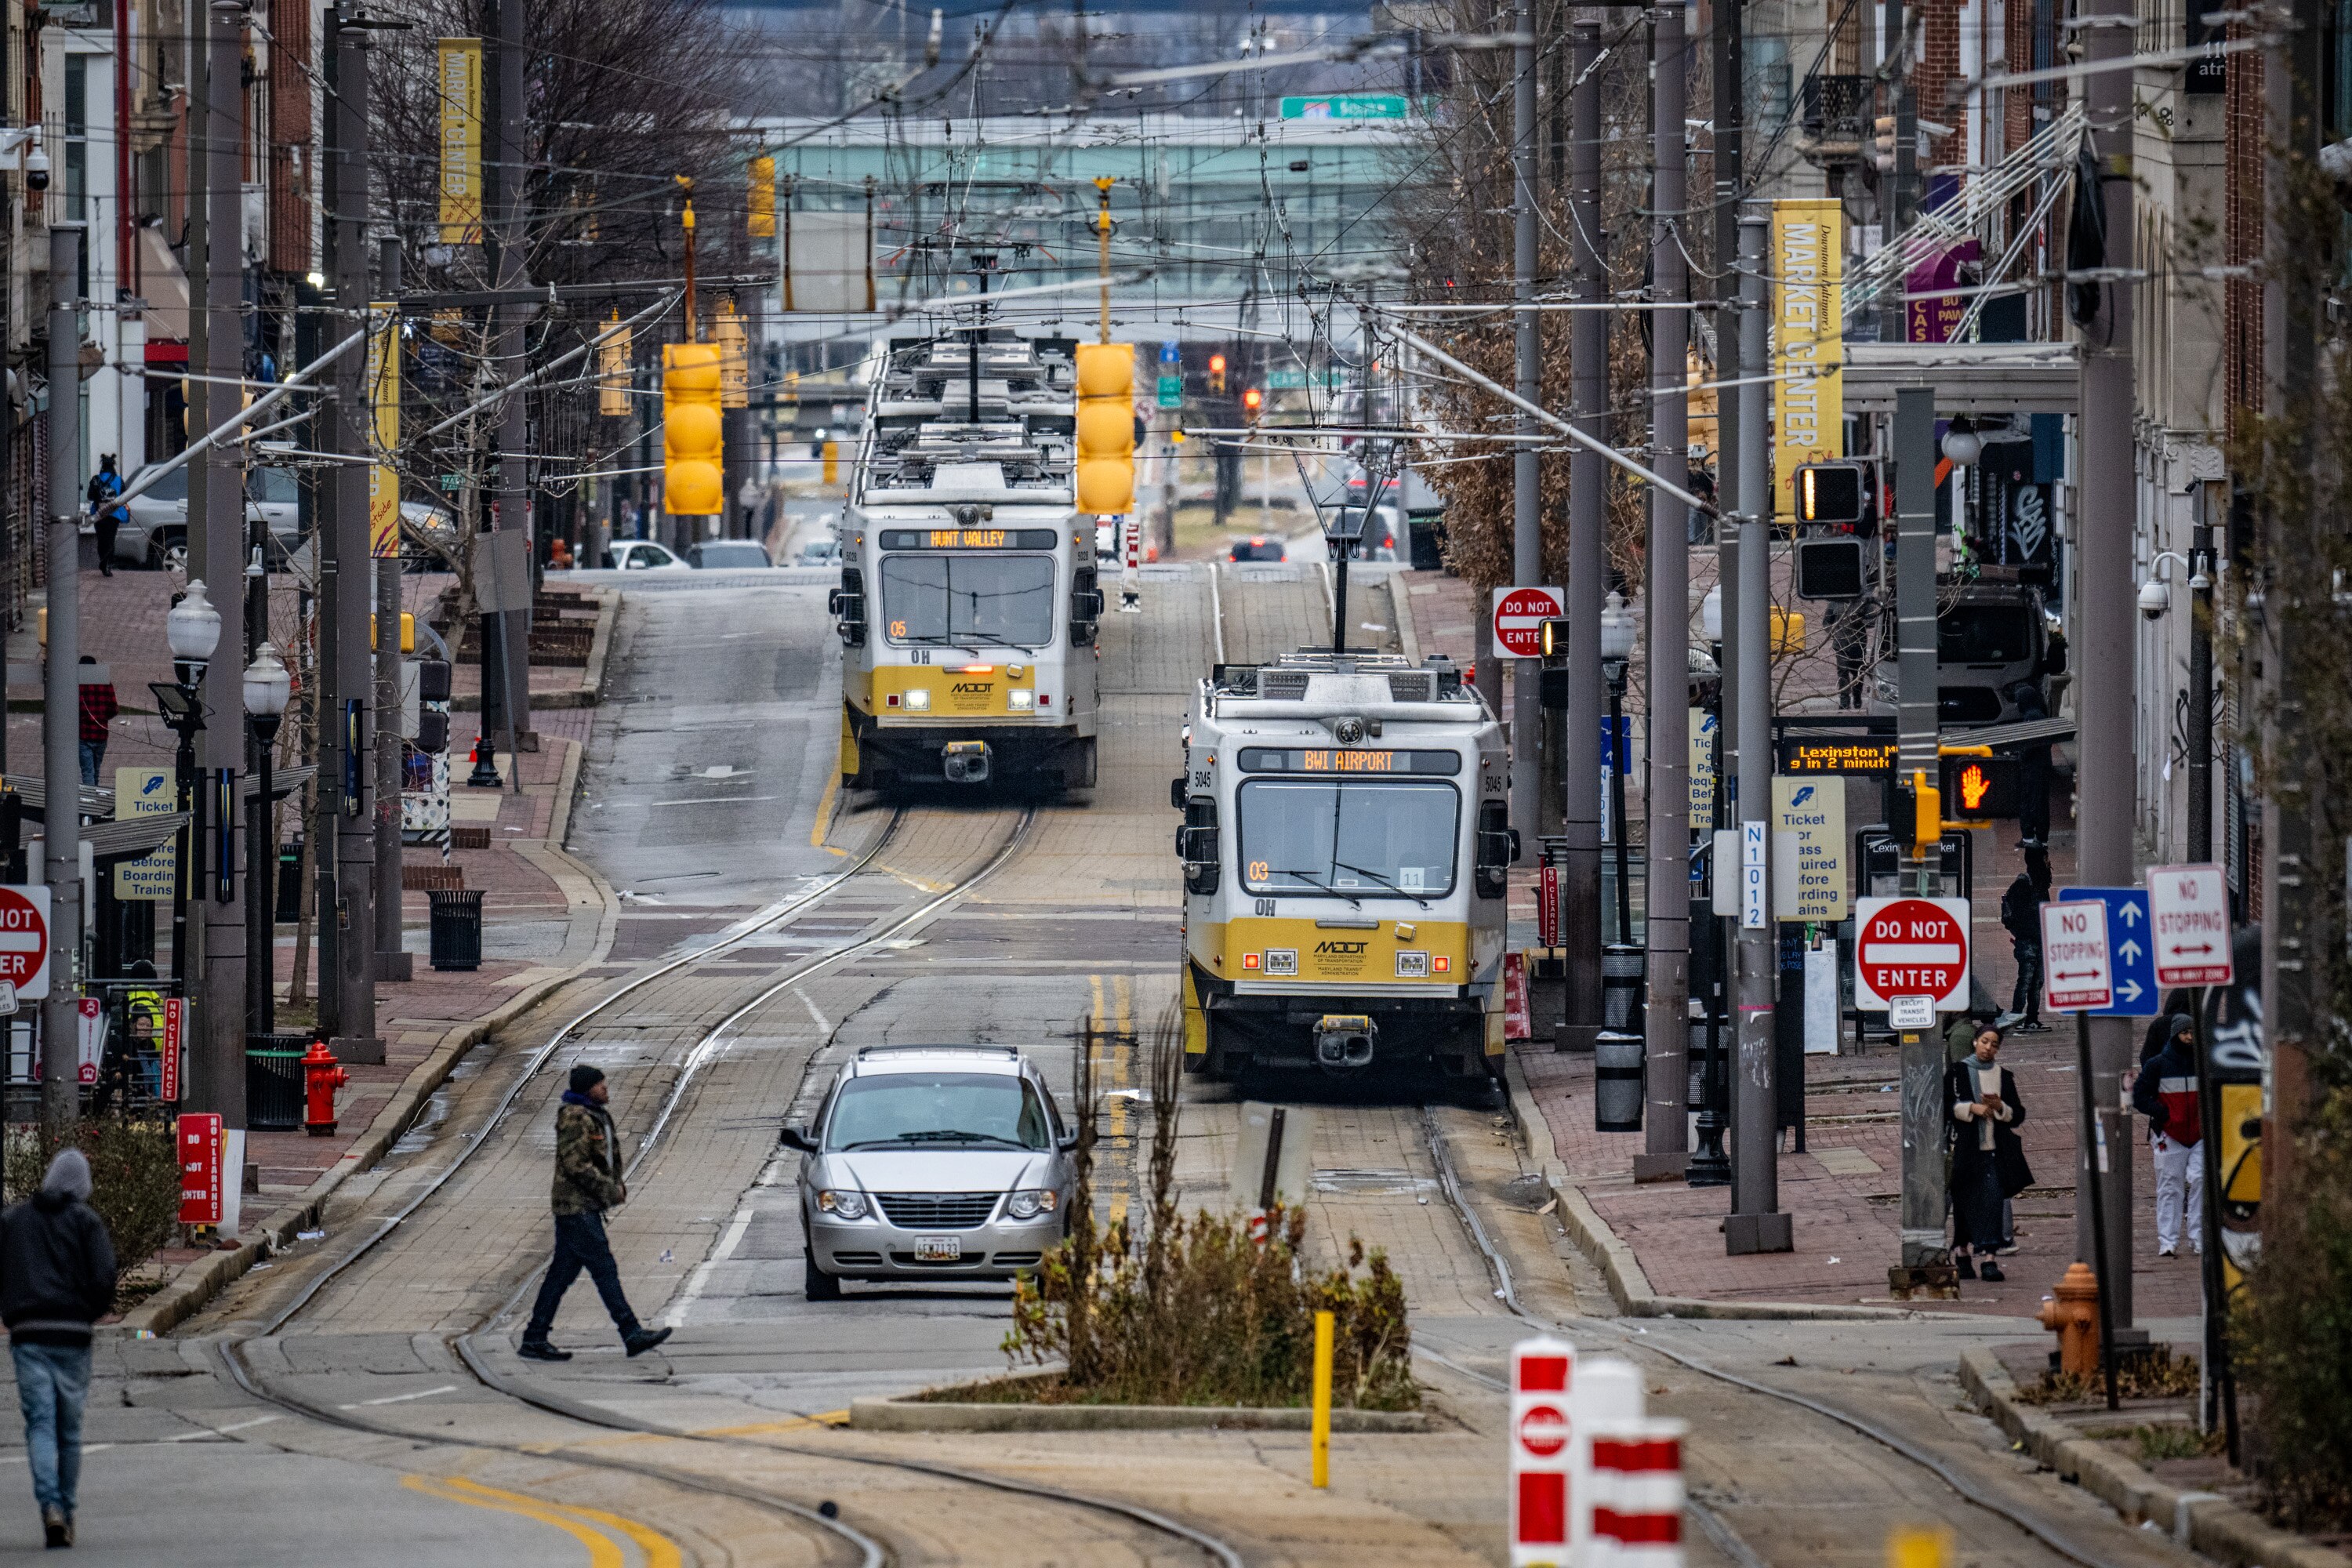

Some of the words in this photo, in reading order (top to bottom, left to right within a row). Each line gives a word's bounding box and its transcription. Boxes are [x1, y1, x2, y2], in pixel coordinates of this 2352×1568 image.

[2198, 63, 2225, 76] atr
[445, 52, 467, 125] MARKET
[445, 128, 467, 196] CENTER
[1821, 224, 1831, 277] Downtown
[1784, 223, 1817, 332] MARKET
[1821, 279, 1833, 332] Baltimore's
[1942, 296, 1959, 307] BU
[1914, 301, 1928, 342] CAS
[1938, 311, 1963, 321] PAW
[1785, 341, 1817, 448] CENTER
[931, 530, 959, 546] HUNT
[964, 530, 1004, 546] VALLEY
[846, 551, 858, 562] 5028
[1077, 550, 1089, 561] 5028
[1505, 601, 1522, 613] DO
[1528, 601, 1552, 613] NOT
[891, 621, 906, 637] 05
[1506, 632, 1539, 644] ENTE
[951, 683, 994, 692] MDOT
[1693, 739, 1711, 748] Tic
[1799, 746, 1878, 758] Lexington
[1305, 750, 1329, 770] BWI
[1335, 751, 1394, 771] AIRPORT
[1807, 757, 1821, 768] in
[1827, 757, 1838, 768] 2
[1697, 764, 1711, 773] Pa
[1194, 771, 1211, 788] 5045
[1485, 776, 1501, 793] 5045
[1693, 789, 1712, 798] Bef
[134, 800, 174, 811] Ticket
[1693, 813, 1711, 823] Tra
[1783, 814, 1826, 825] Ticket
[1798, 847, 1822, 855] ass
[1940, 843, 1956, 852] ket
[1801, 858, 1837, 869] uired
[123, 870, 174, 881] Boardin
[1249, 860, 1269, 881] 03
[1548, 869, 1555, 883] NO
[1403, 873, 1421, 887] 11
[1798, 875, 1829, 884] fore
[132, 884, 173, 895] Trains
[1798, 889, 1838, 902] rding
[2179, 879, 2198, 901] NO
[1798, 904, 1828, 915] ains
[1875, 920, 1902, 938] DO
[1911, 920, 1949, 938] NOT
[2061, 913, 2087, 933] NO
[2159, 911, 2222, 935] STOPPING
[1314, 941, 1369, 954] MDOT
[2049, 942, 2104, 963] STOPPING
[1877, 970, 1947, 987] ENTER
[169, 1003, 177, 1019] NO
[166, 1023, 176, 1098] CLEARANCE
[210, 1117, 218, 1136] NO
[187, 1134, 200, 1145] DO
[182, 1190, 207, 1200] ENTER
